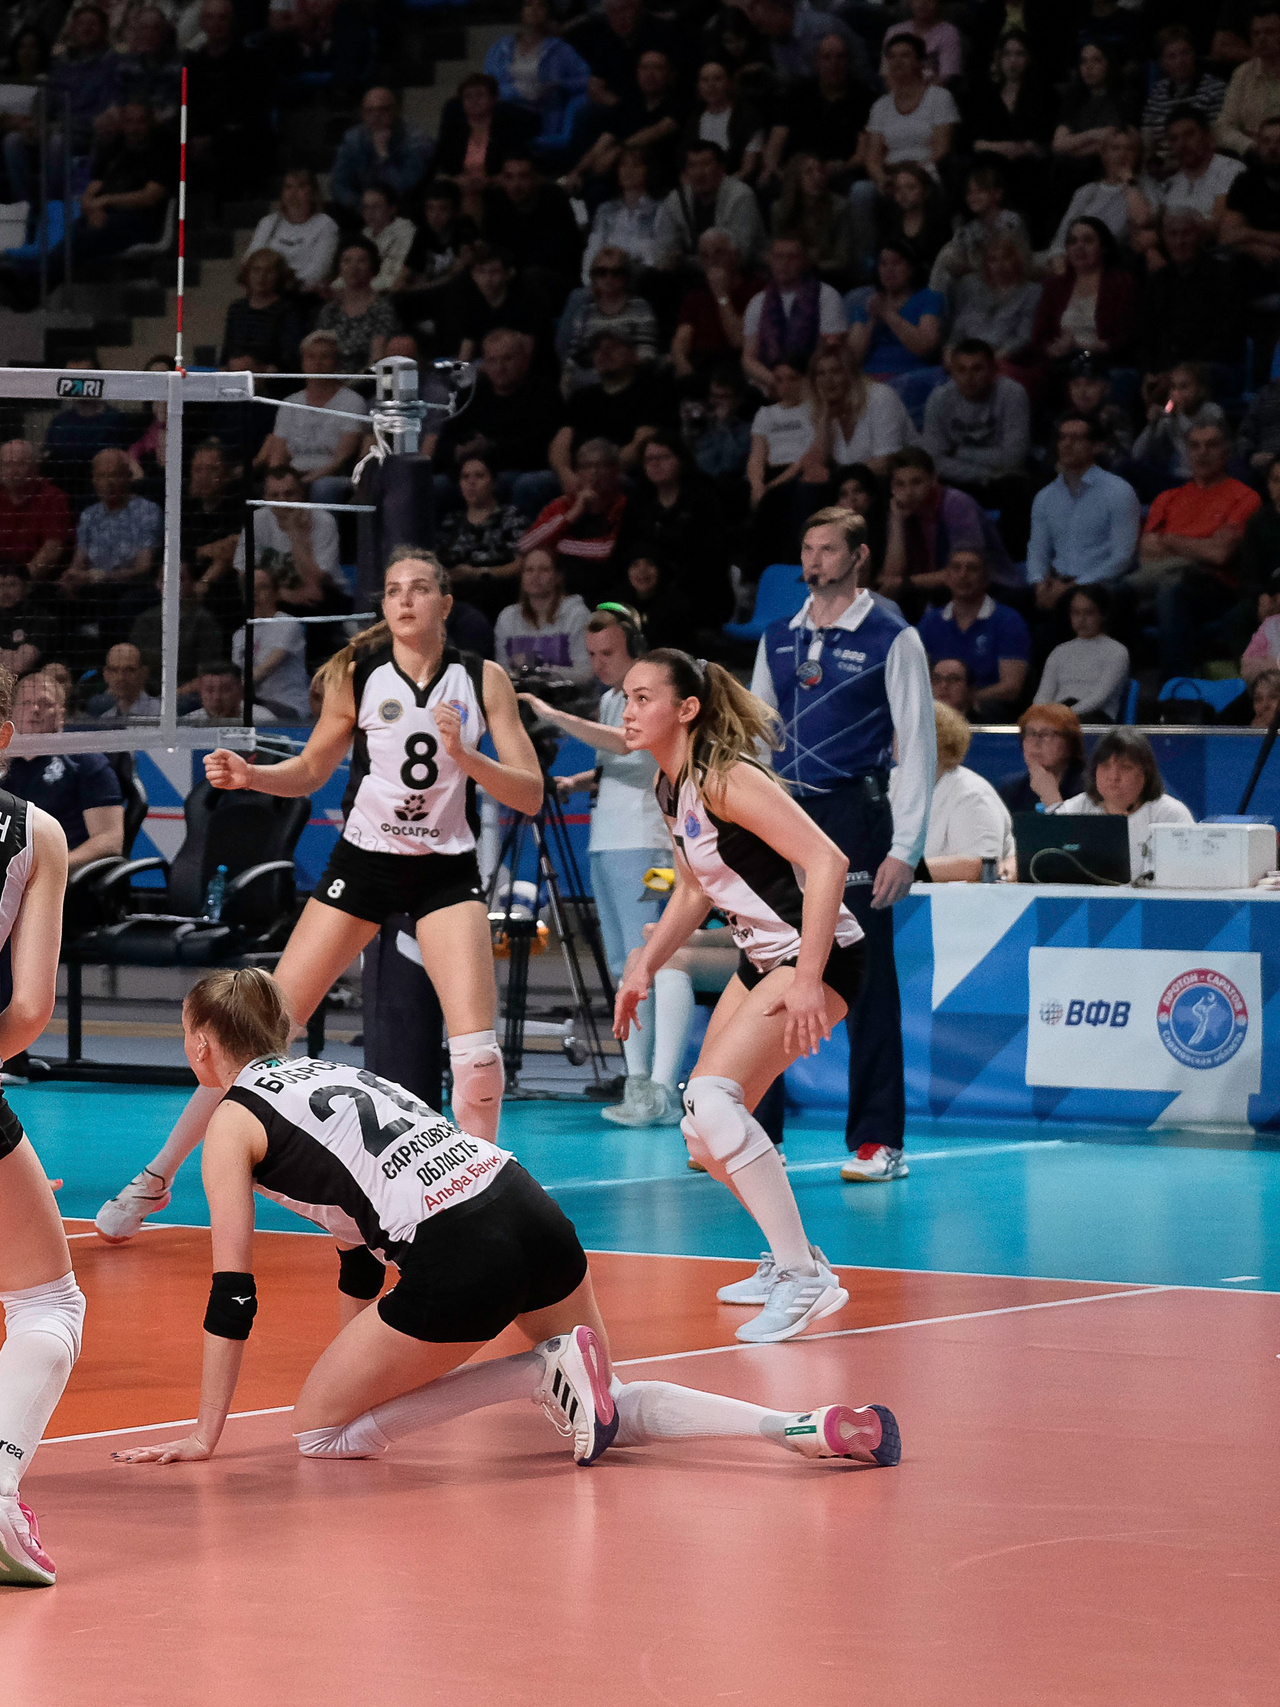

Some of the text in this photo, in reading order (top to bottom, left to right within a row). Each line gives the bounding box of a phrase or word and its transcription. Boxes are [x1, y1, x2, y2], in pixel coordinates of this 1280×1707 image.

[60, 379, 101, 397] PARI
[400, 731, 439, 790] 8
[381, 823, 440, 838] ФОСАГРО
[327, 878, 346, 899] 8
[1065, 999, 1131, 1027] ВФВ
[416, 1140, 479, 1187] ОБЛАСТЬ
[424, 1156, 501, 1212] Альфа Банк
